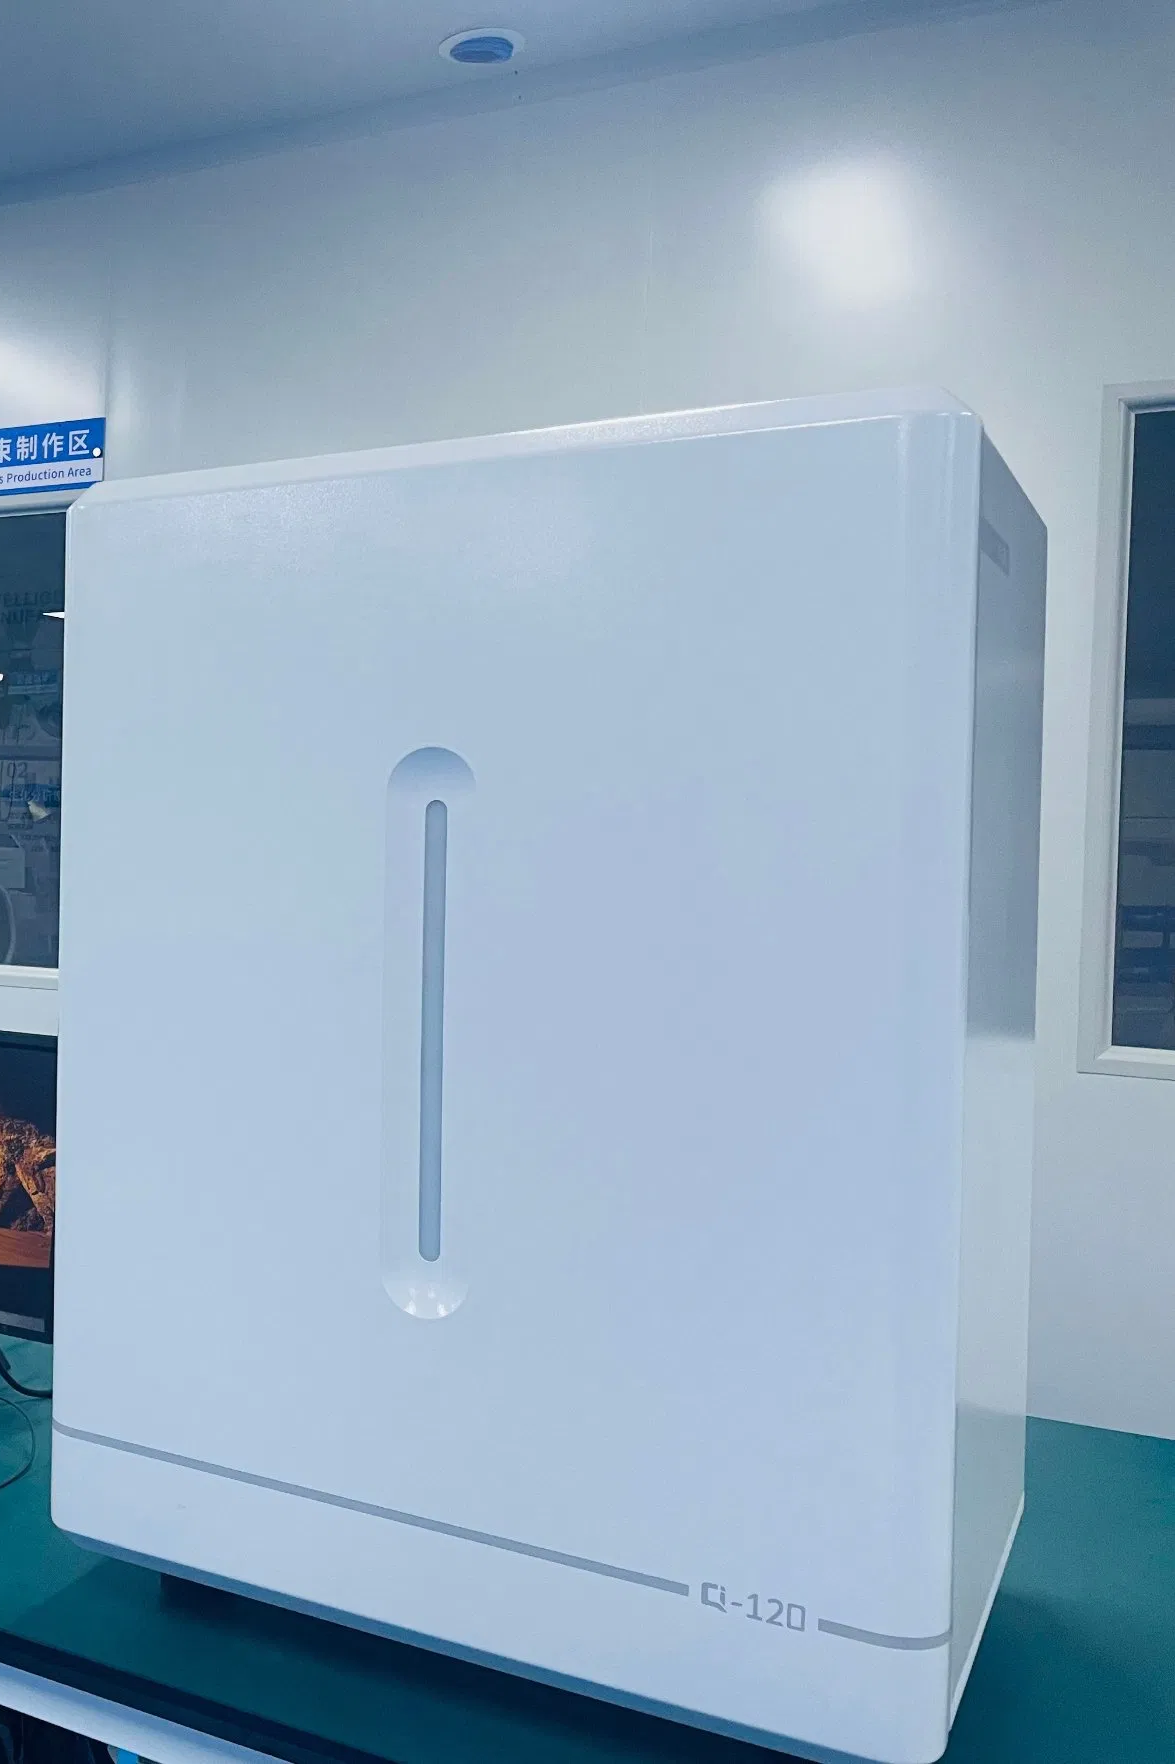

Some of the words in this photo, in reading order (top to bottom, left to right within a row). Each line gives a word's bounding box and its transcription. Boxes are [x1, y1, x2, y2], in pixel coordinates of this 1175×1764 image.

[7, 468, 65, 484] Production
[68, 466, 93, 478] Area
[7, 762, 28, 778] 02
